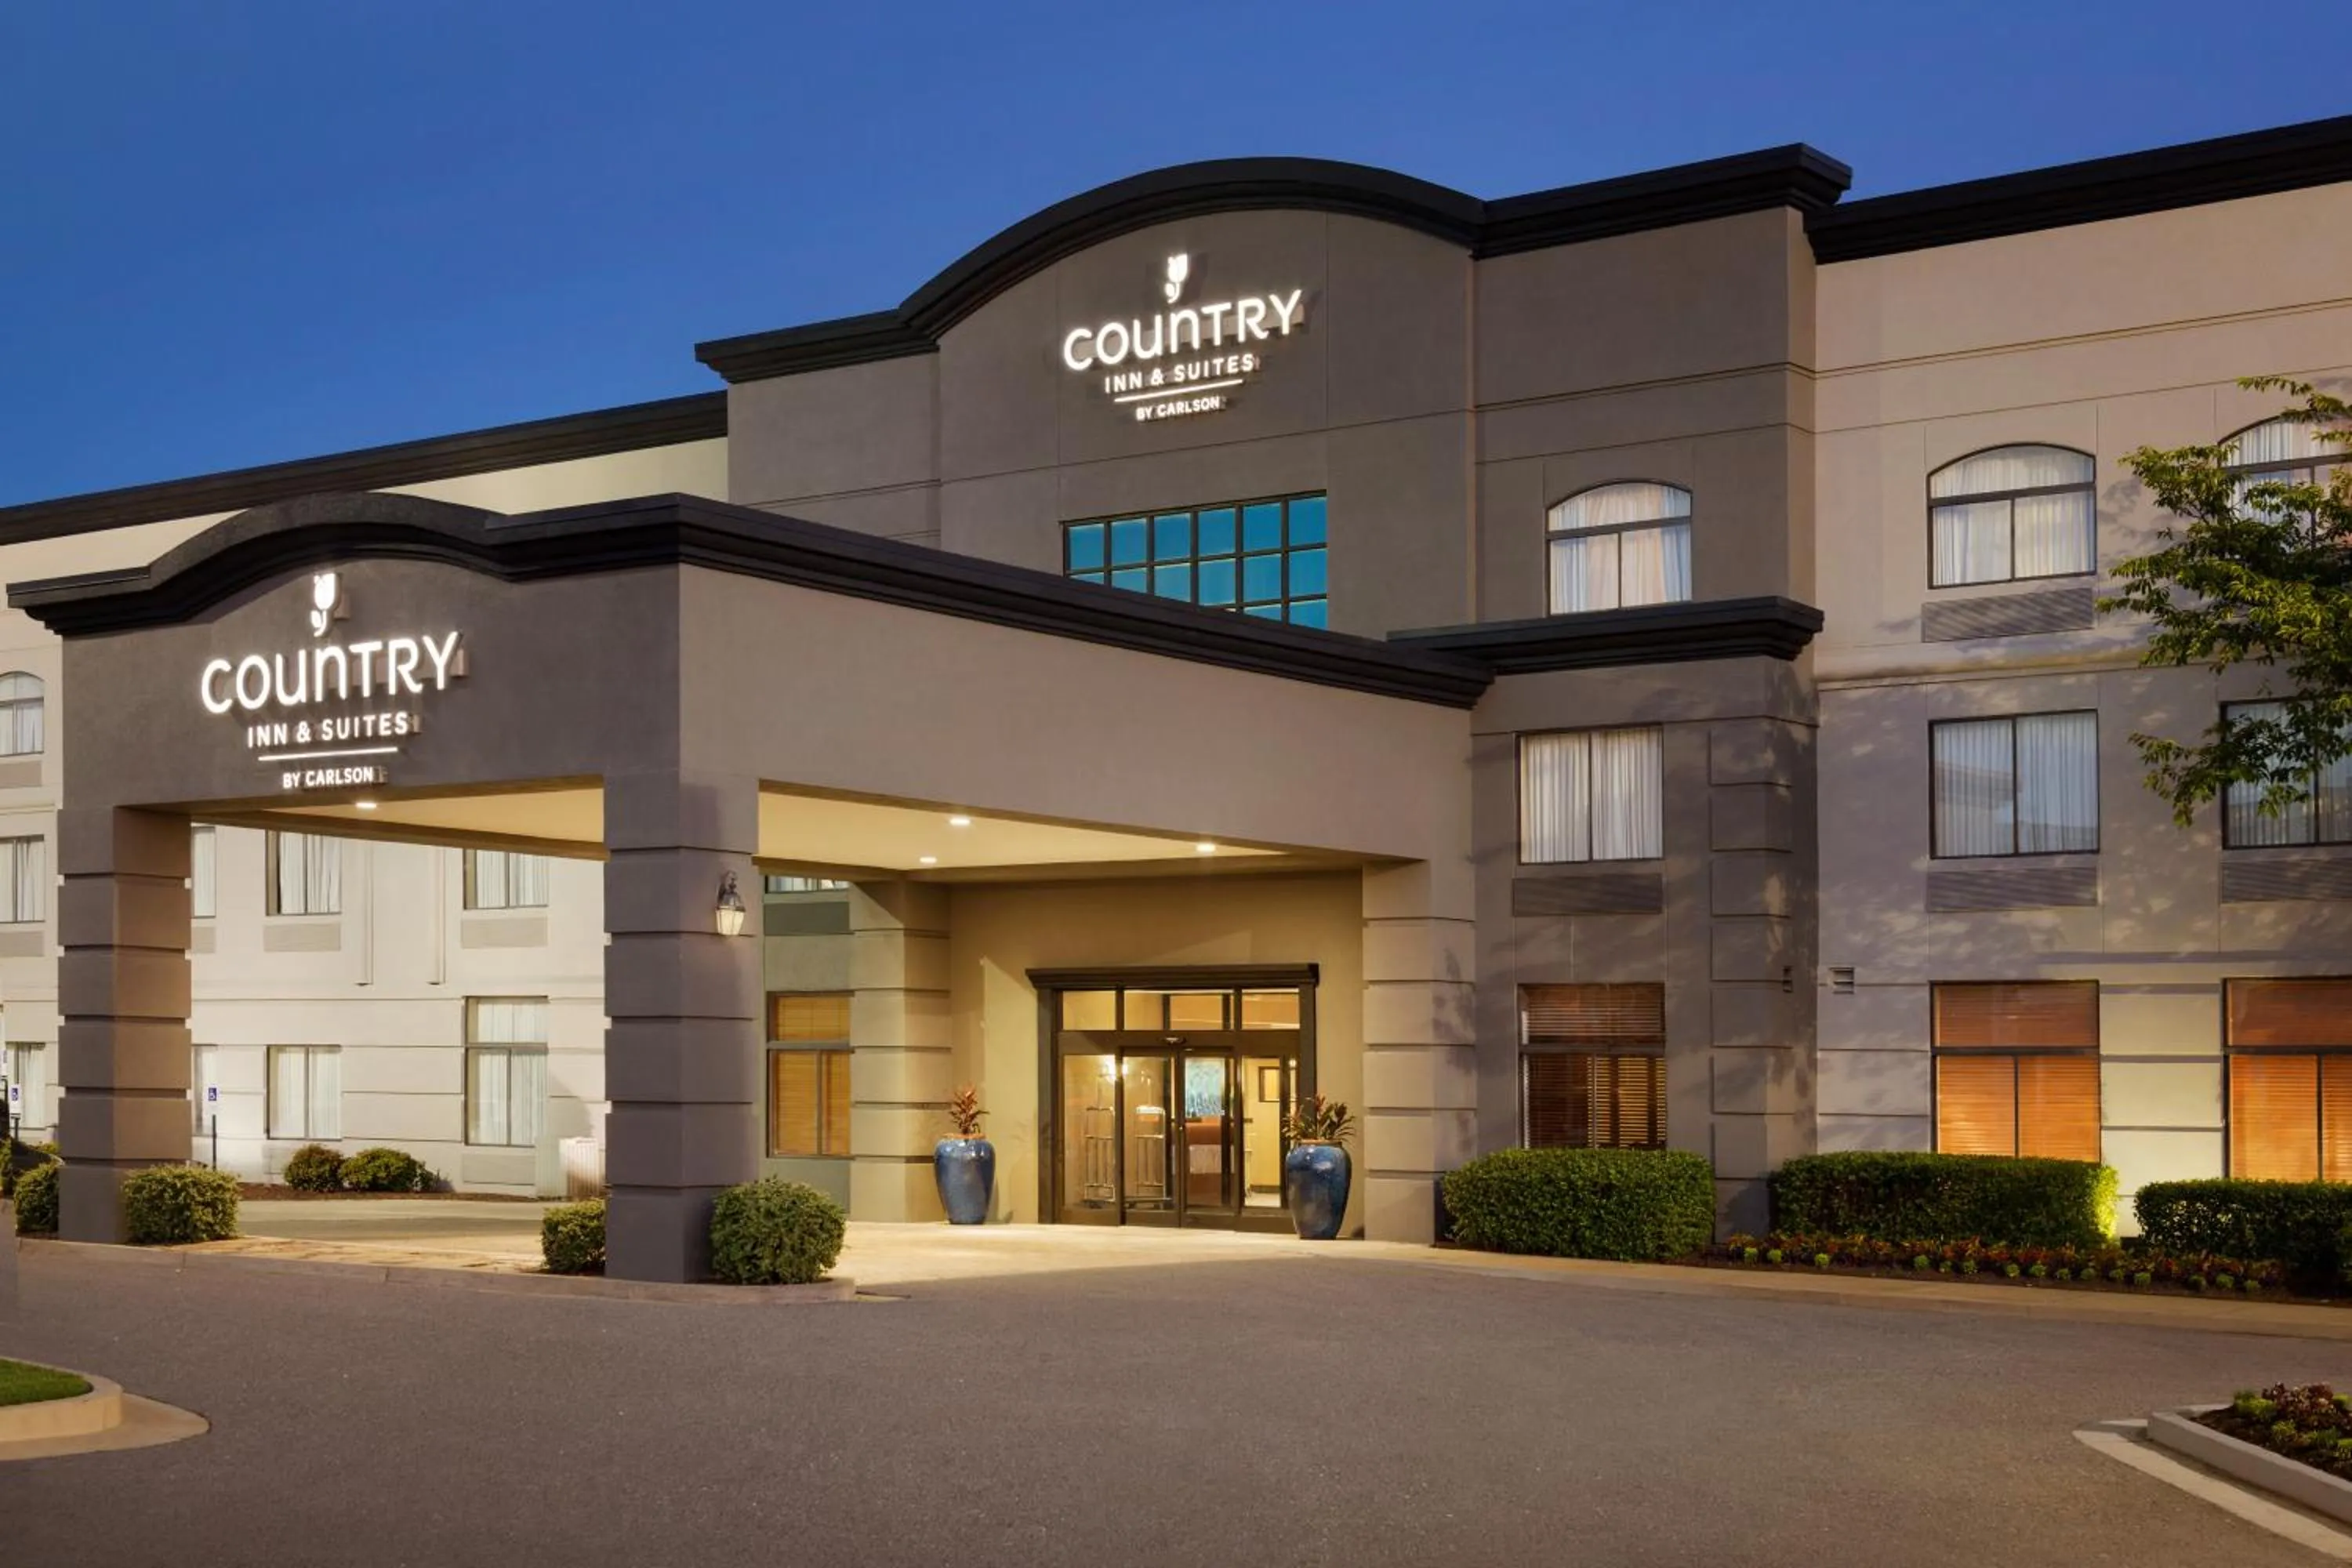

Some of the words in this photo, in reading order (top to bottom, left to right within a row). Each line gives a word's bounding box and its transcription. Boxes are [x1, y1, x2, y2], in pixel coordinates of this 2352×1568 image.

[1105, 372, 1143, 394] INN
[1149, 367, 1165, 387] &
[1173, 353, 1255, 383] SUITES
[1136, 405, 1153, 421] BY
[1156, 395, 1221, 418] CARLSON
[247, 722, 289, 749] INN
[295, 720, 312, 744] &
[320, 710, 408, 741] SUITES
[282, 771, 301, 789] BY
[304, 766, 374, 787] CARLSON
